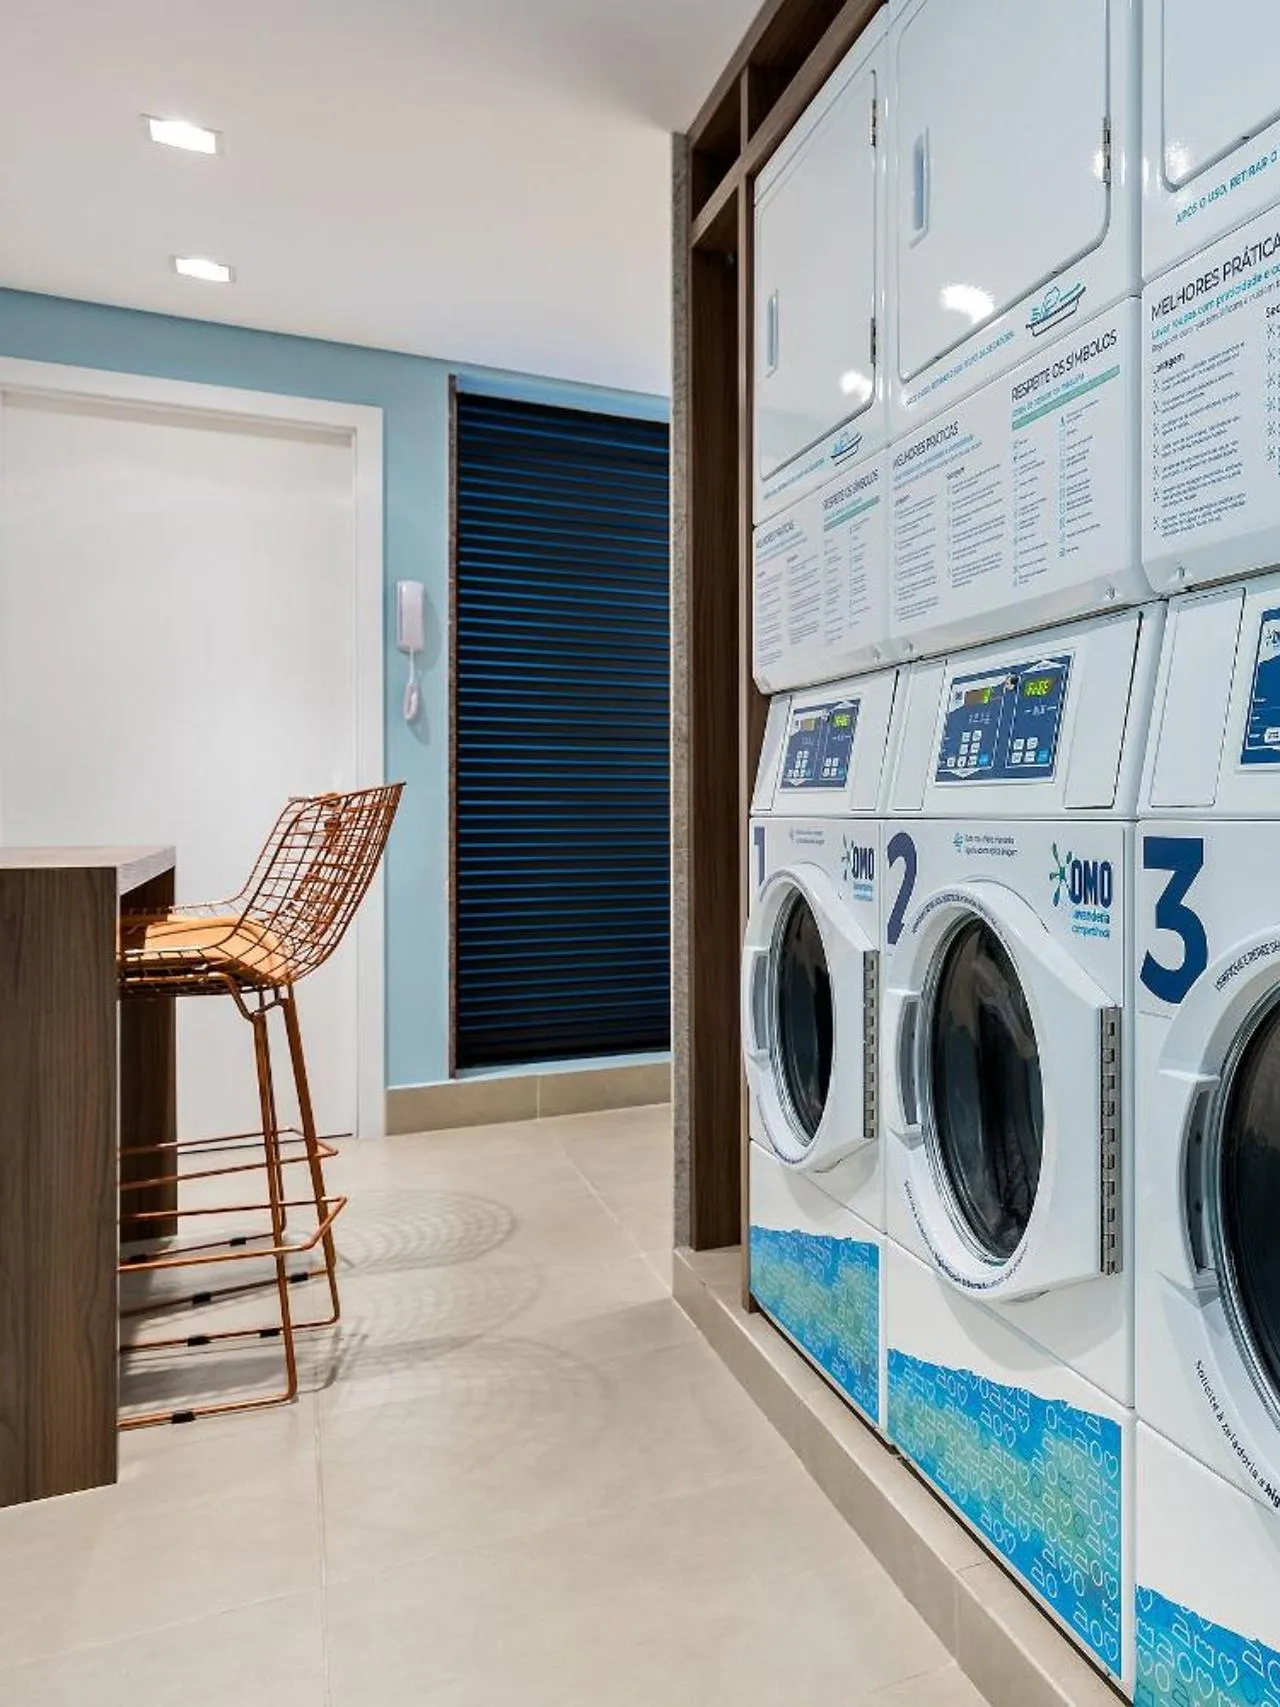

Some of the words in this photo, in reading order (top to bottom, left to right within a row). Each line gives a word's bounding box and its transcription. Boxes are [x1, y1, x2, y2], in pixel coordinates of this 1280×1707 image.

[1152, 268, 1219, 321] MELHORES
[754, 826, 765, 886] 1
[851, 846, 875, 882] OMO
[1069, 858, 1113, 908] OMO
[887, 831, 917, 945] 2
[1139, 836, 1209, 1004] 3
